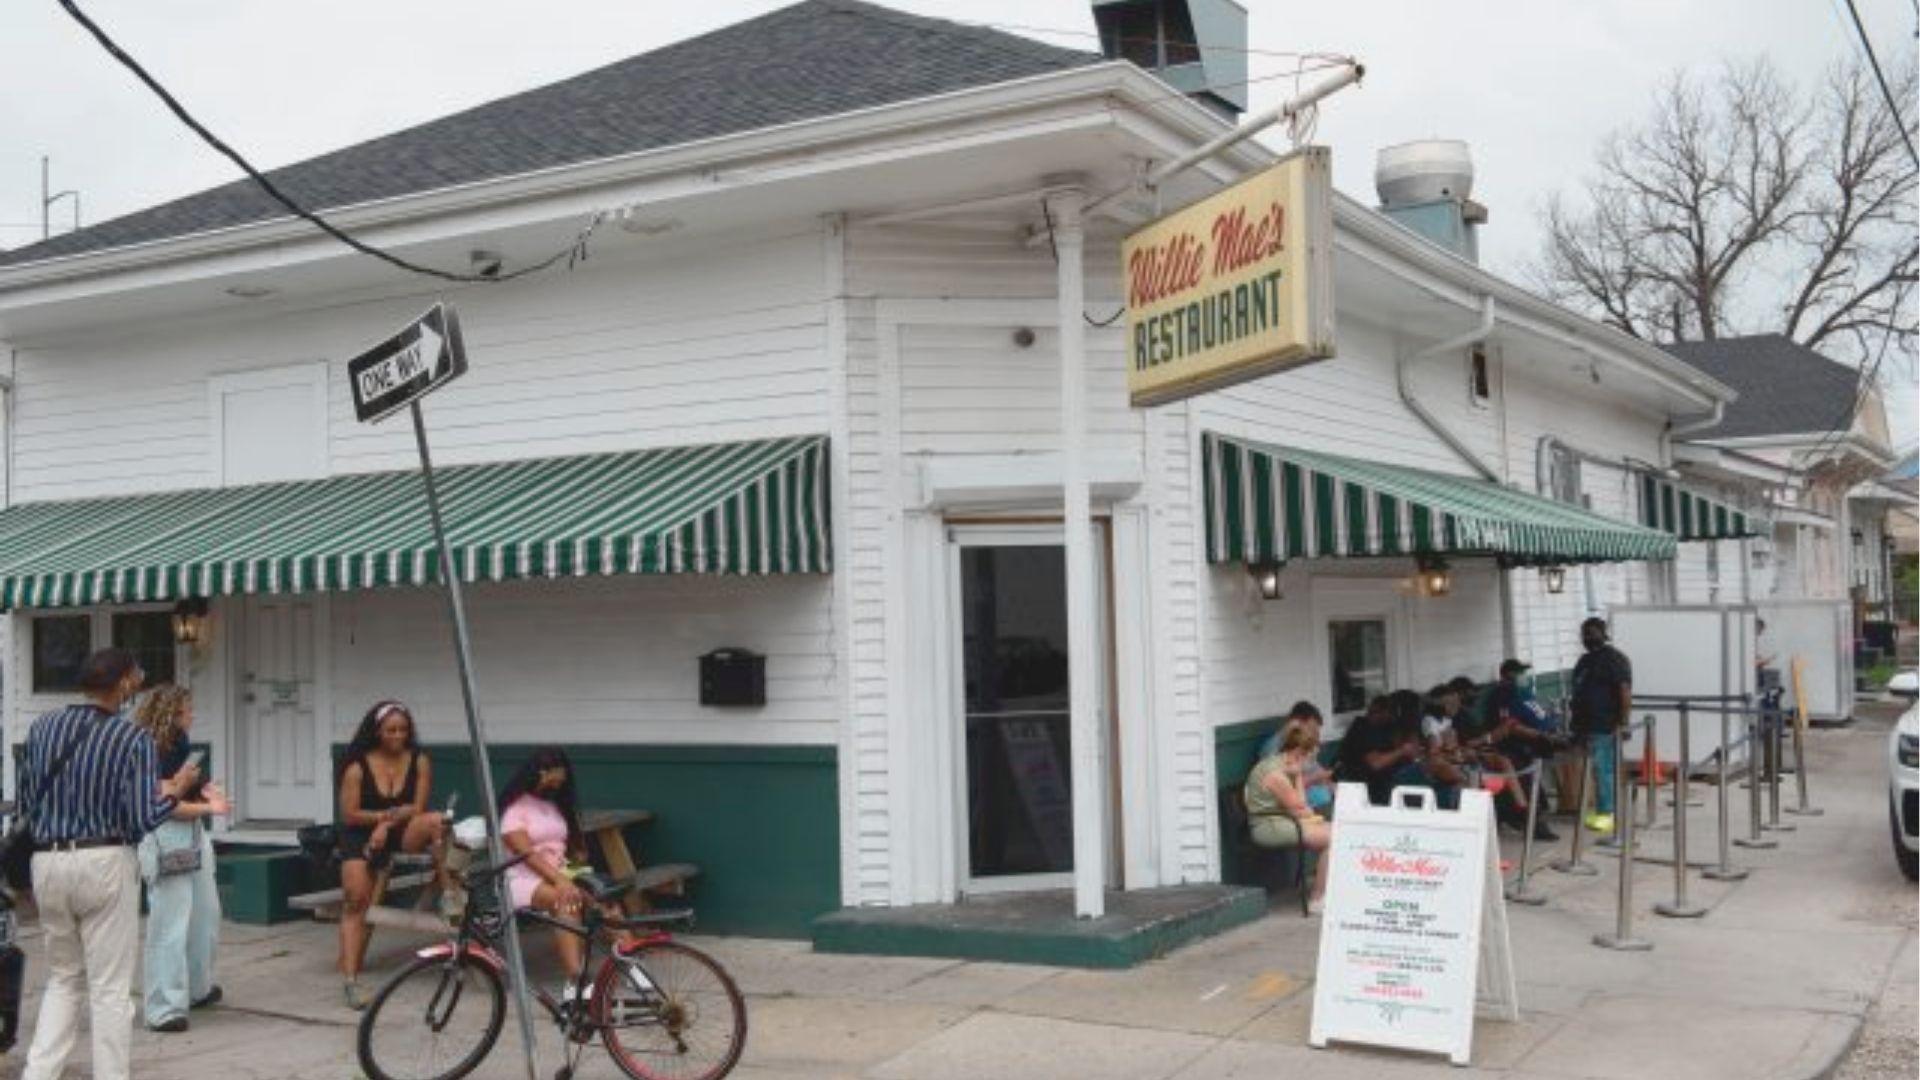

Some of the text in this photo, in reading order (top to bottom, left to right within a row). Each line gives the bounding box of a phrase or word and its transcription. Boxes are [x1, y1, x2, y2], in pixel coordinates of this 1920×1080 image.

[1129, 202, 1285, 308] Willie Mae's
[364, 344, 421, 396] ONE WAY
[1134, 269, 1282, 371] RESTAURANT
